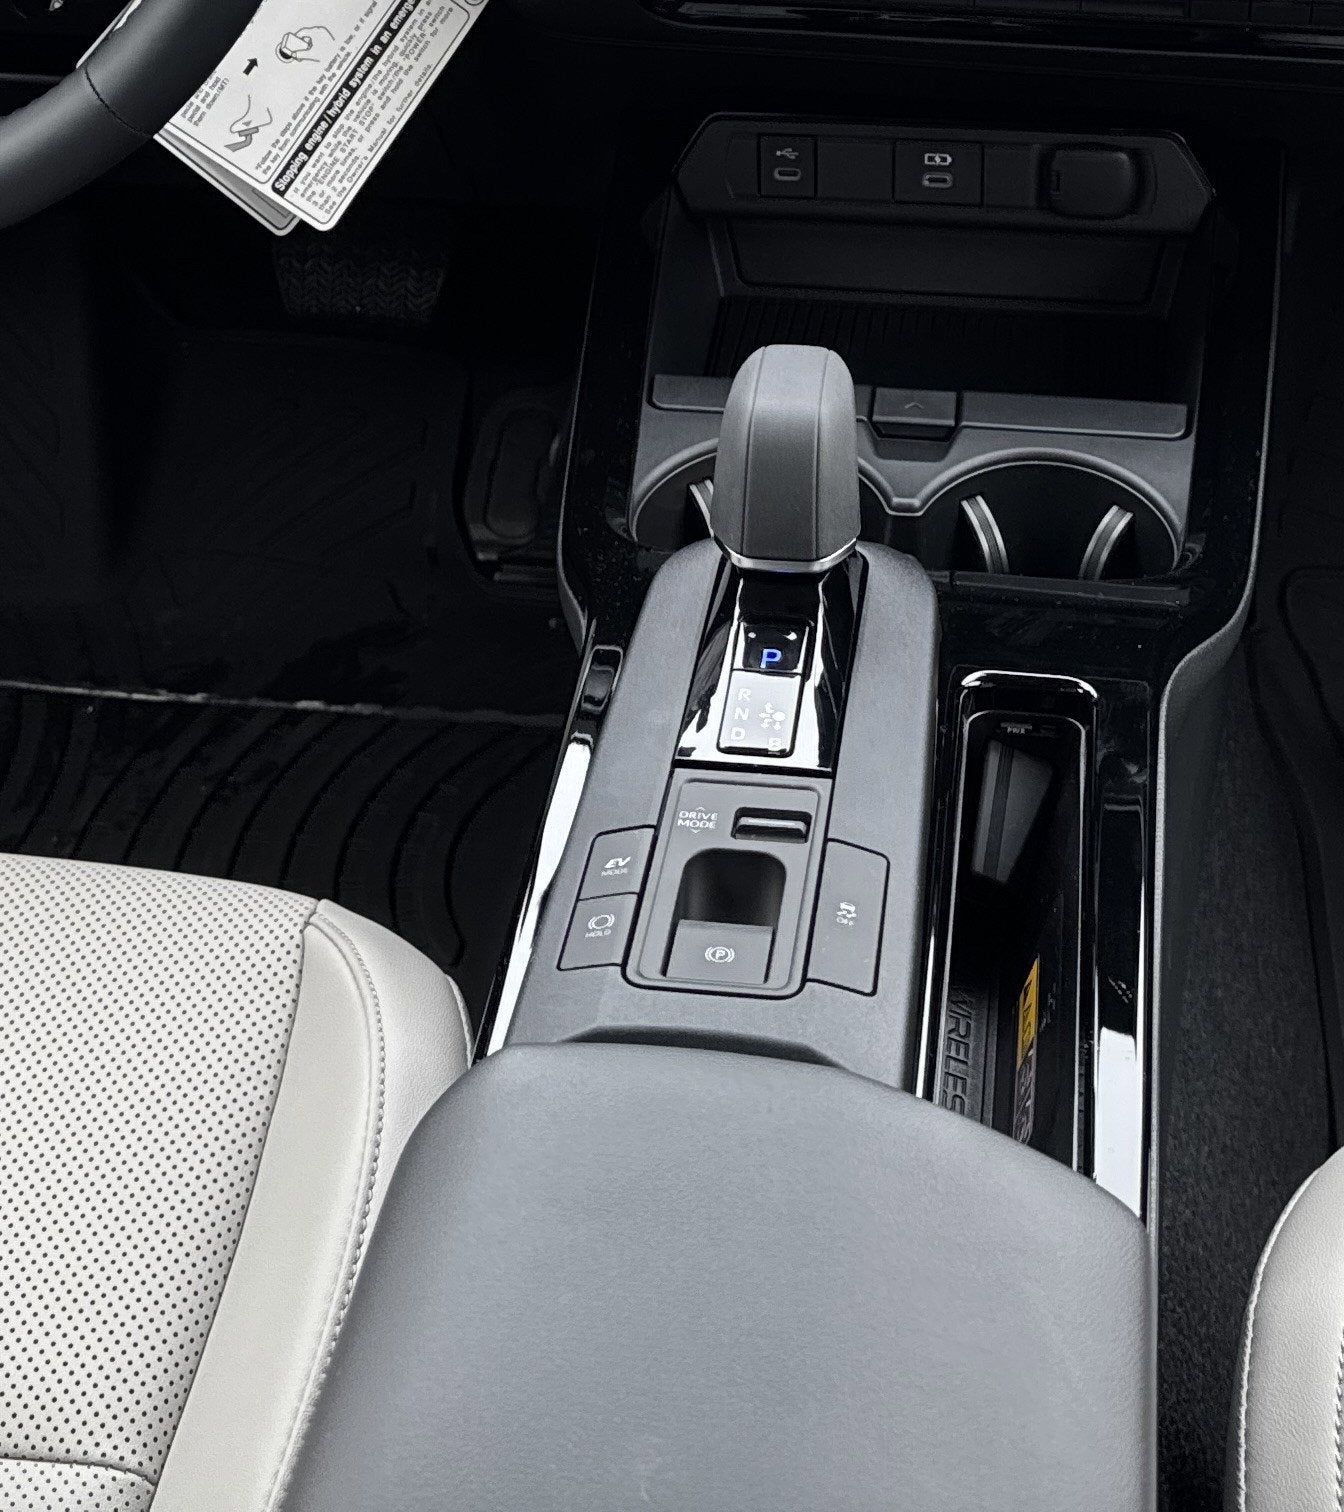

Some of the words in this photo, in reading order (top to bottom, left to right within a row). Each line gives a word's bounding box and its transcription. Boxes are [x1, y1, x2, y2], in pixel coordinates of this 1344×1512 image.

[273, 150, 310, 193] Stopping
[345, 54, 377, 90] system
[369, 42, 383, 57] in
[378, 29, 393, 45] an
[759, 648, 783, 669] P
[737, 688, 752, 701] R
[733, 707, 749, 721] N
[731, 728, 746, 741] D
[678, 810, 718, 821] DRIVE
[677, 819, 717, 830] MODE
[601, 867, 629, 876] MODE
[585, 928, 612, 938] HOLD
[941, 991, 974, 1115] WIRELES
